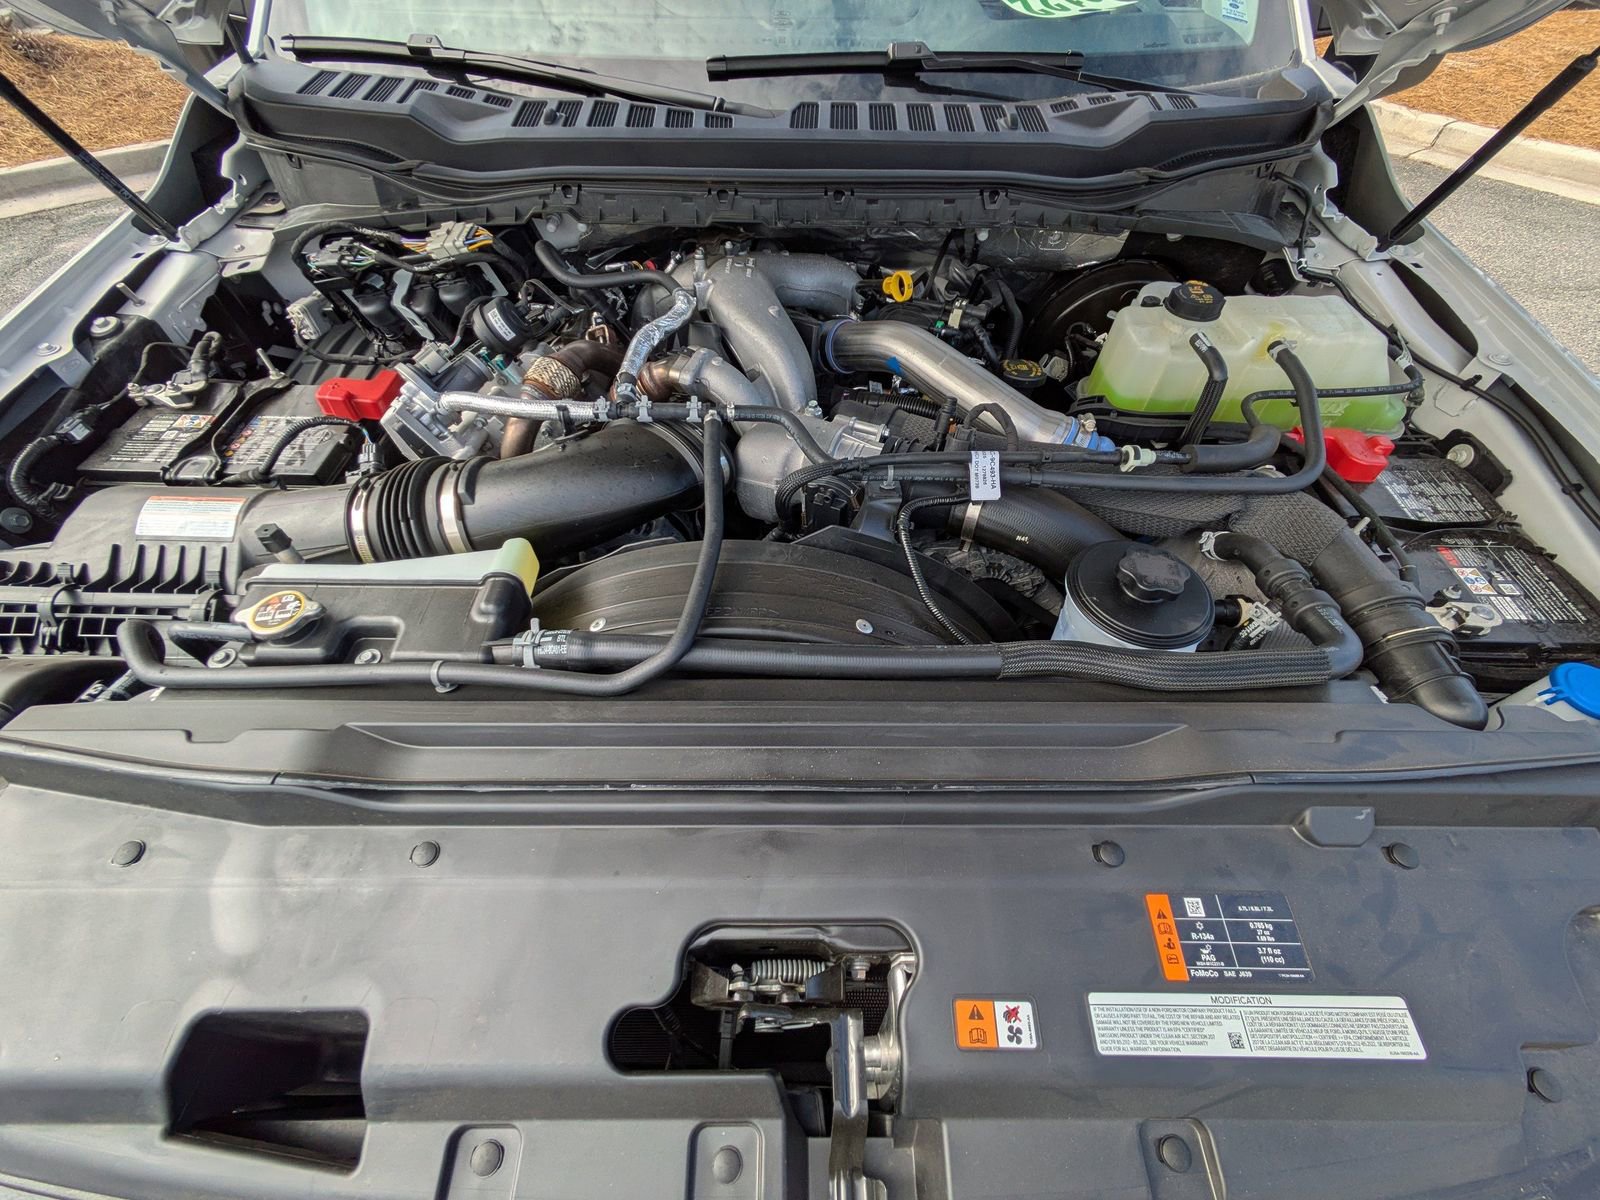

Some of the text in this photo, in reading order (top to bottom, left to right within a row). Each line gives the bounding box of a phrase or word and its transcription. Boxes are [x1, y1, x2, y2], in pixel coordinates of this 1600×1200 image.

[1265, 922, 1273, 931] kg
[1191, 932, 1214, 940] R-134a
[1261, 956, 1285, 964] (110 cc)
[1211, 996, 1272, 1005] MODIFICATION
